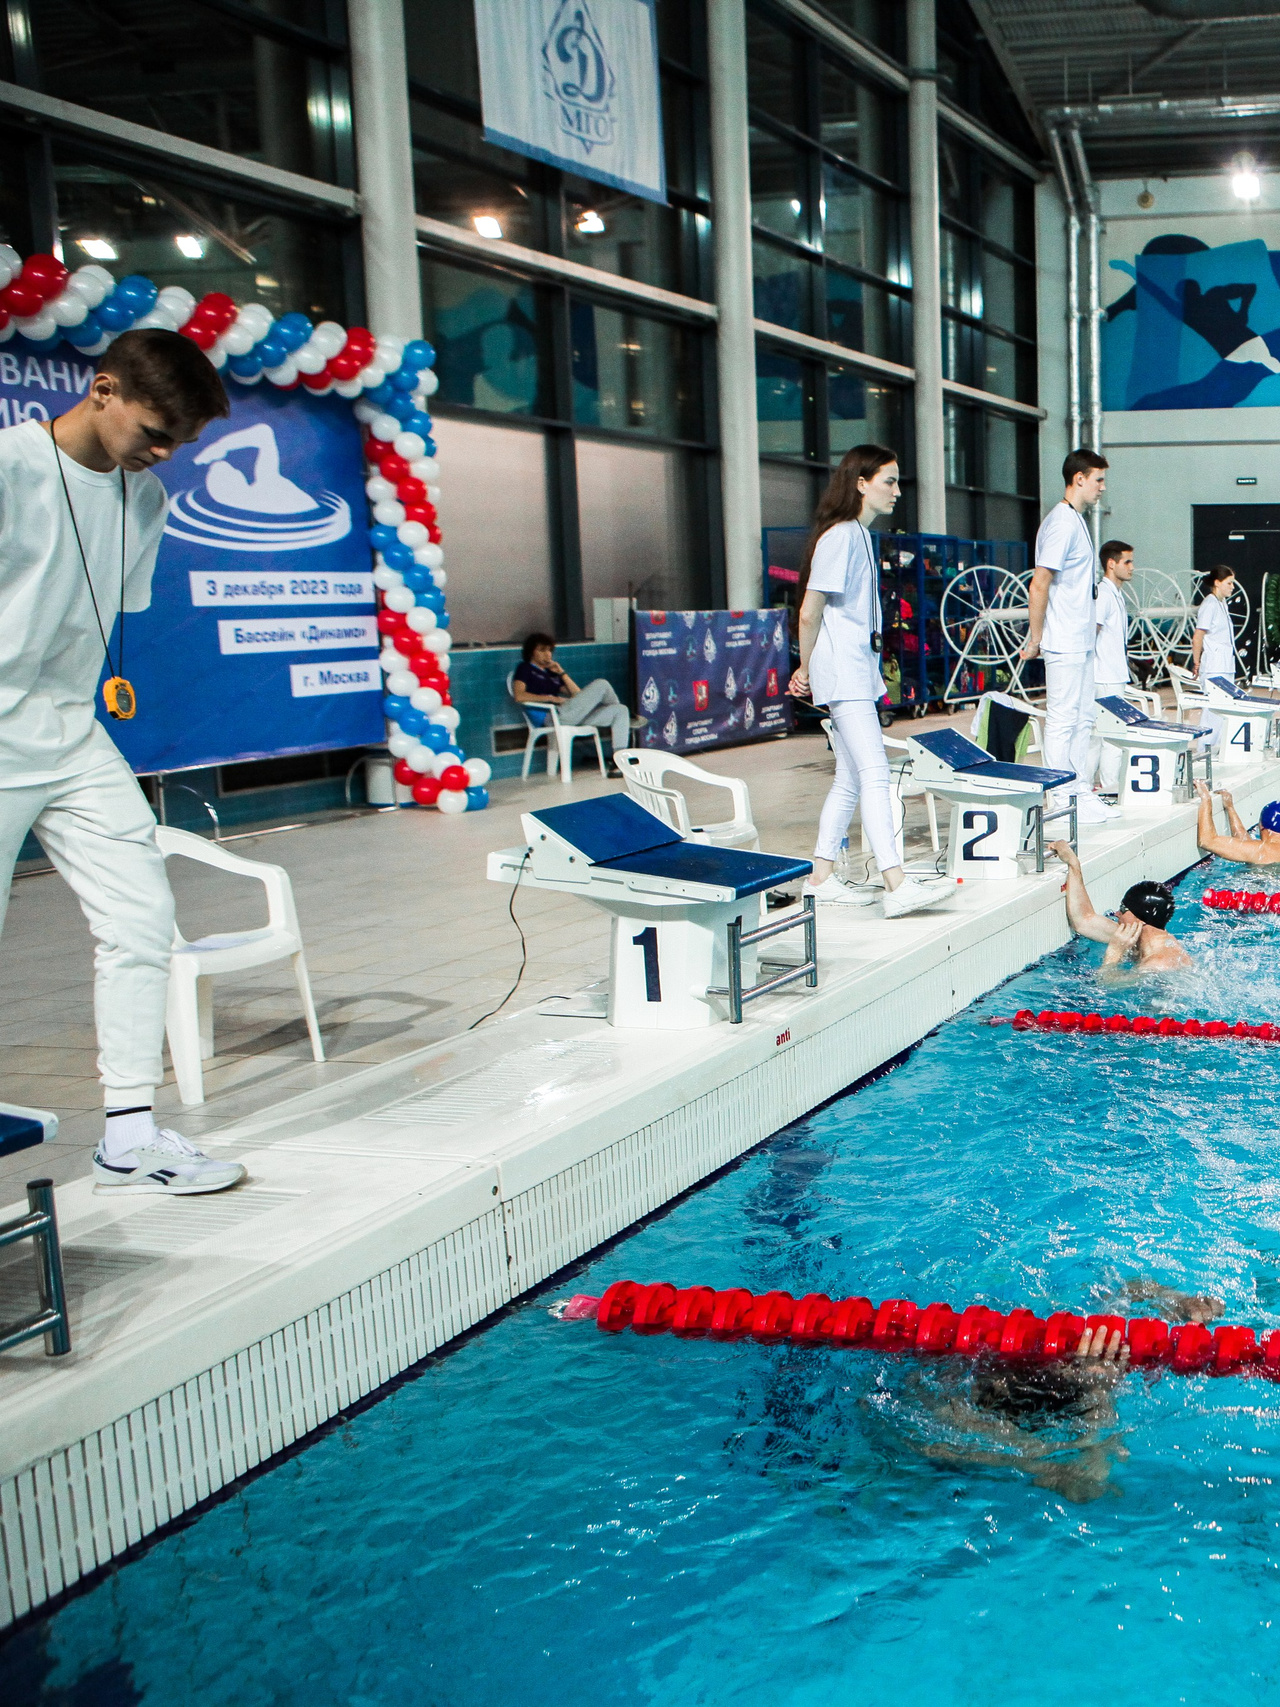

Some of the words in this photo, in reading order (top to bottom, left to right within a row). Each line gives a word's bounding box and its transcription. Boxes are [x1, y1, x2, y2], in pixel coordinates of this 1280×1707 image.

[206, 579, 218, 596] 3
[223, 580, 285, 600] декабря
[290, 579, 329, 596] 2023
[333, 581, 363, 597] года
[233, 626, 296, 644] Бассейн
[300, 624, 368, 643] «Динамо»
[303, 675, 315, 687] г.
[319, 670, 370, 686] Москва
[1230, 722, 1254, 752] 4
[1130, 755, 1160, 793] 3
[963, 811, 1000, 861] 2
[632, 926, 662, 1003] 1
[776, 1027, 791, 1047] anti
